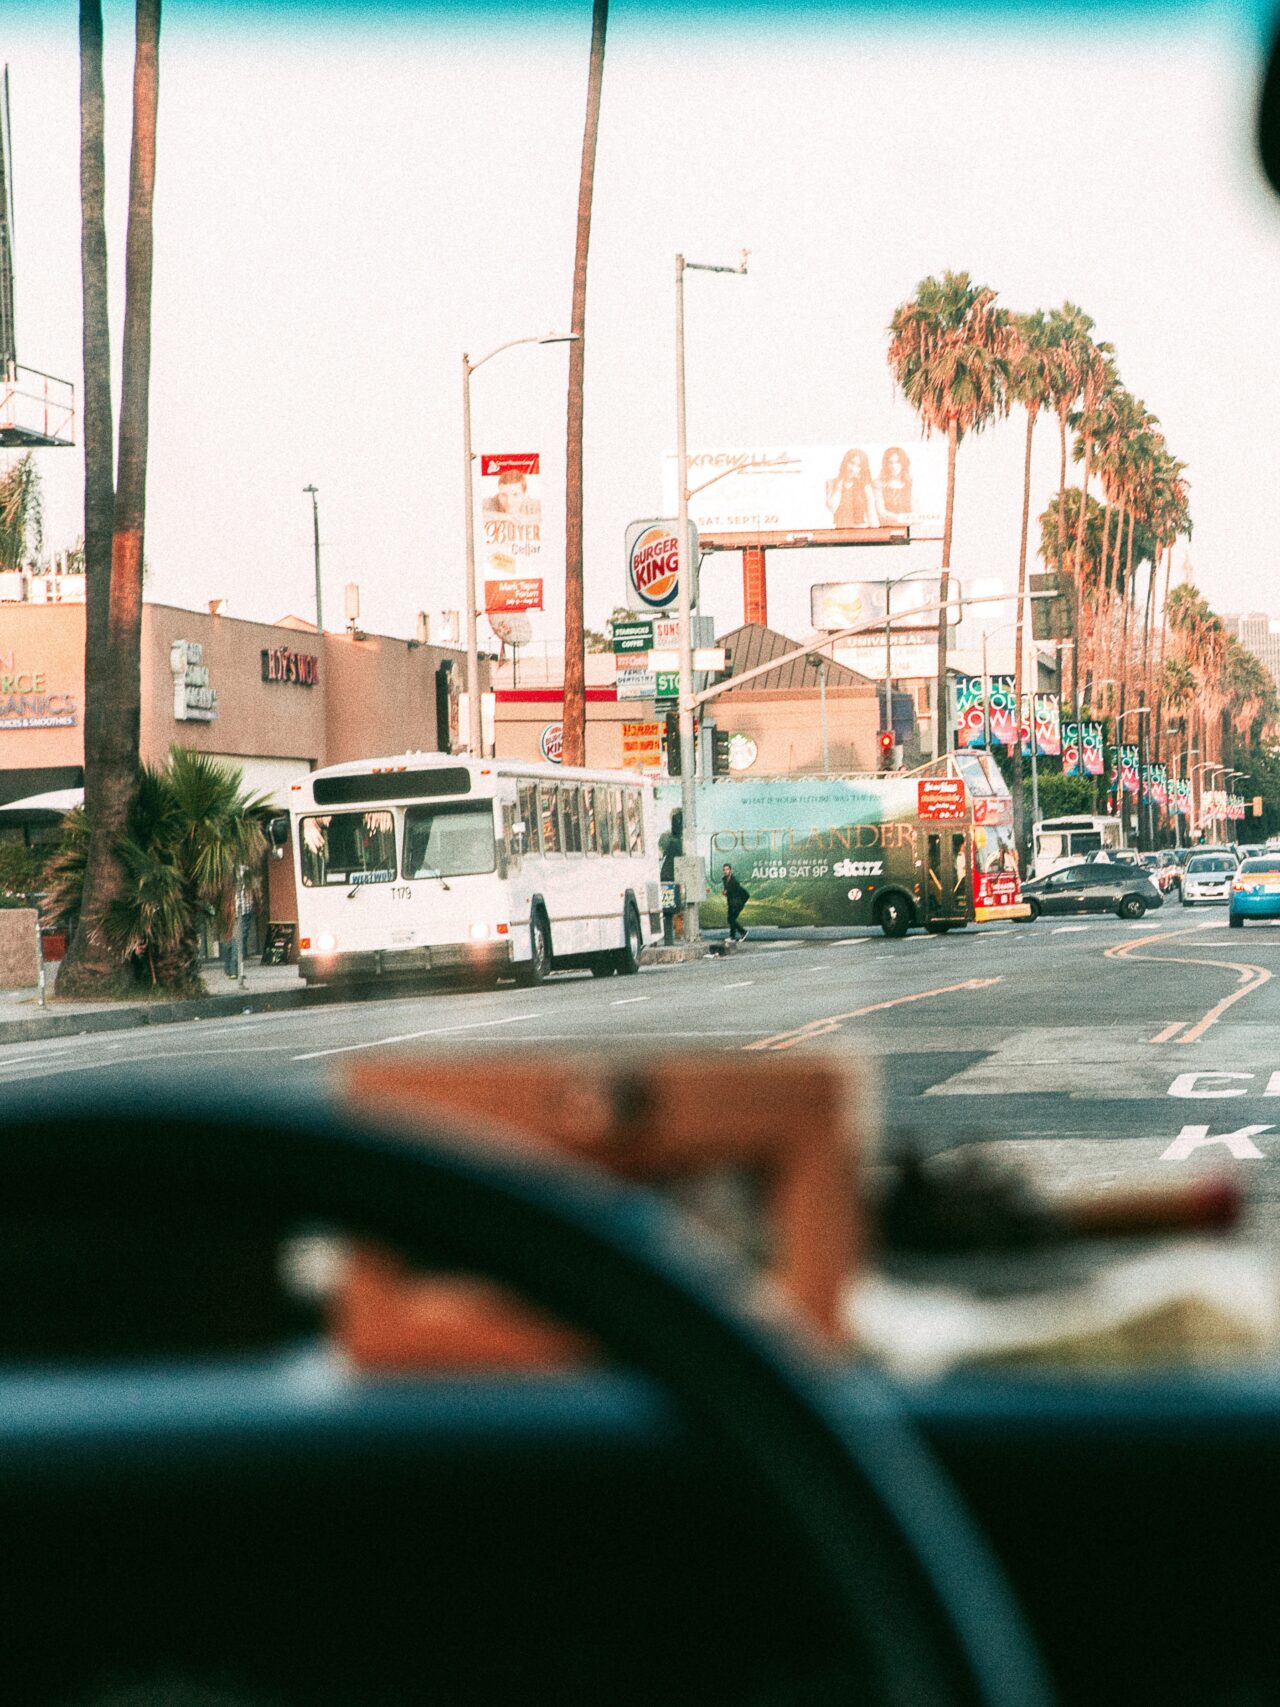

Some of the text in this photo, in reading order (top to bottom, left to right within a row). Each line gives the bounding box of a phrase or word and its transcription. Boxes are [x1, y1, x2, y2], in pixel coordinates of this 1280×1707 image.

[633, 537, 679, 571] BURGER
[635, 552, 679, 592] KING
[616, 627, 650, 636] STARBUCKS
[622, 640, 644, 649] COFFEE
[847, 634, 926, 647] UNIVERSAL
[955, 677, 1016, 694] HOLLY
[957, 710, 1017, 729] BOWL
[1021, 724, 1060, 741] OWL
[714, 823, 917, 852] OUTLANDER
[788, 866, 811, 878] SAT
[812, 865, 829, 878] 9P
[833, 858, 884, 878] starz
